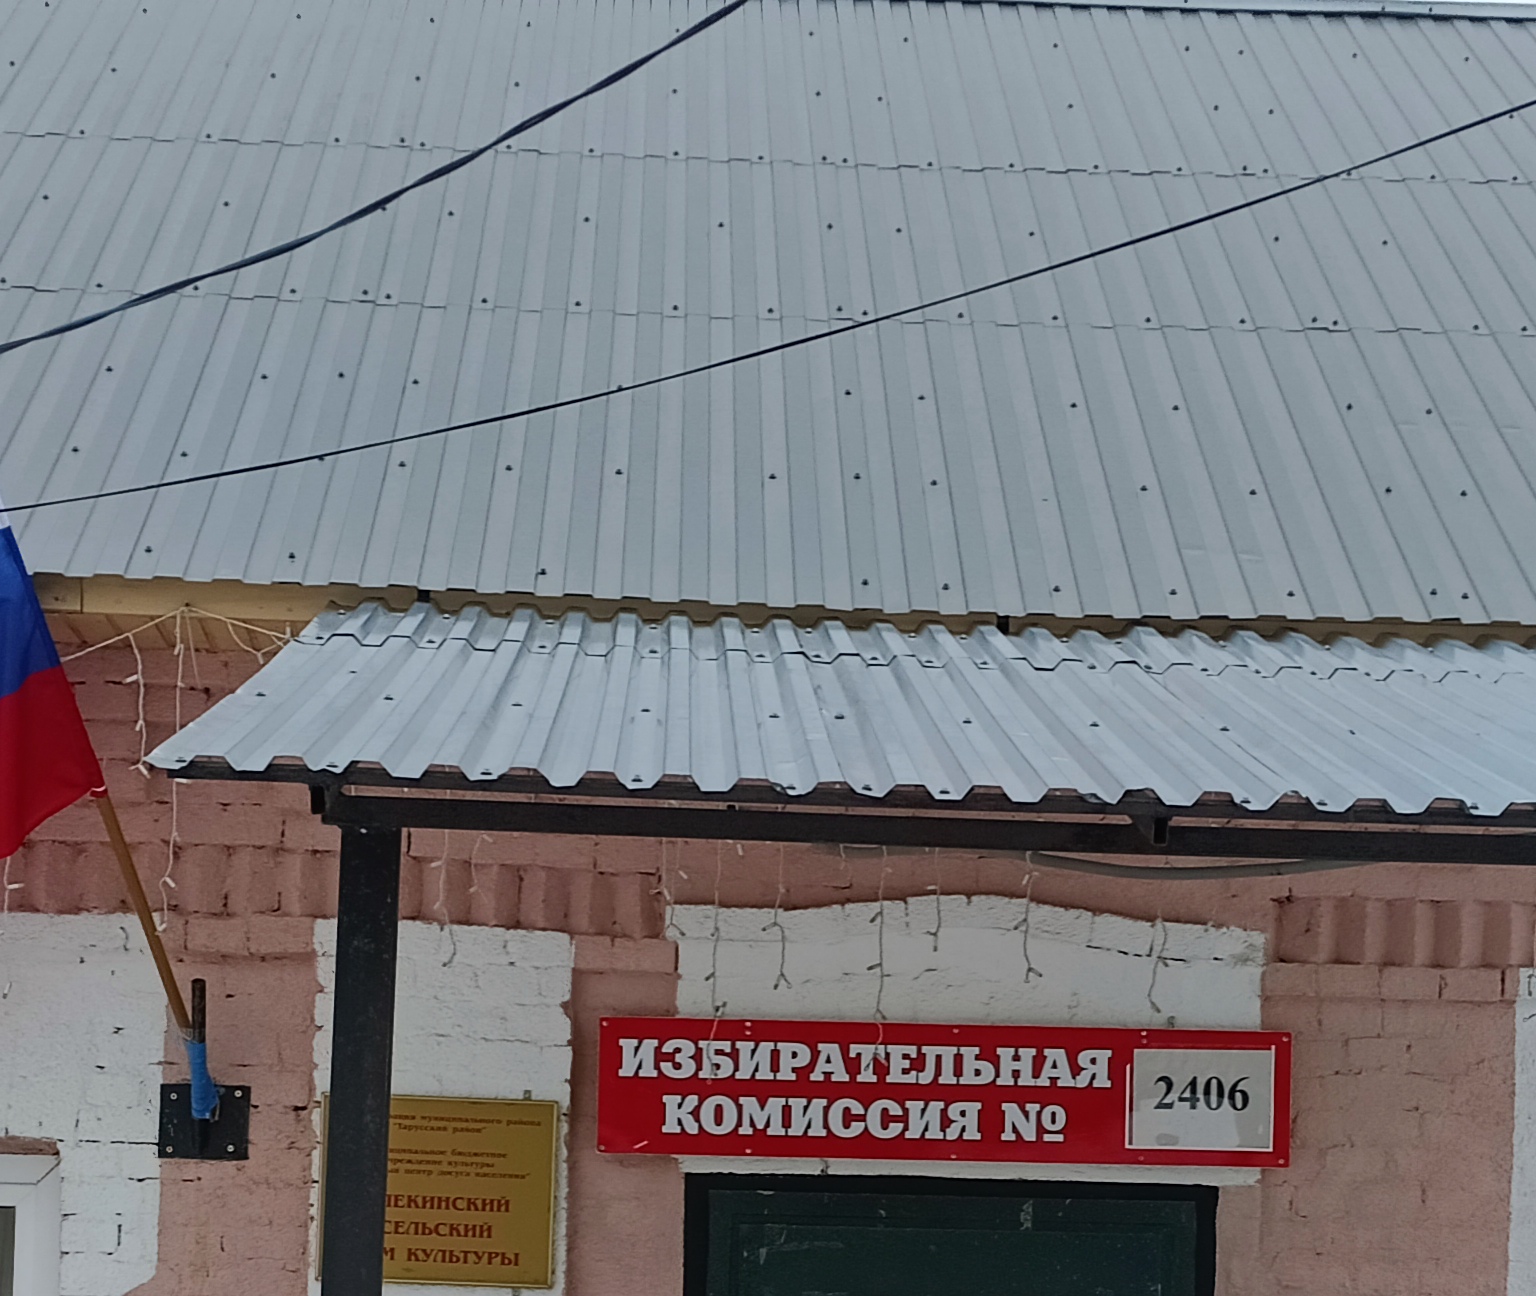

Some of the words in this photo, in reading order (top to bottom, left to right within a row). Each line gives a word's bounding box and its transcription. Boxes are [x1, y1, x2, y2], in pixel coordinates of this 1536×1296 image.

[618, 1038, 1112, 1089] ИЗБИРАТЕЛЬНАЯ
[1153, 1075, 1251, 1113] 2406
[661, 1094, 982, 1141] КОМИССИЯ
[1001, 1102, 1067, 1143] №
[385, 1193, 511, 1213] ЕКИНСКИЙ
[383, 1220, 493, 1239] СЕЛЬСКИЙ
[406, 1247, 521, 1267] КУЛЬТУРЫ
